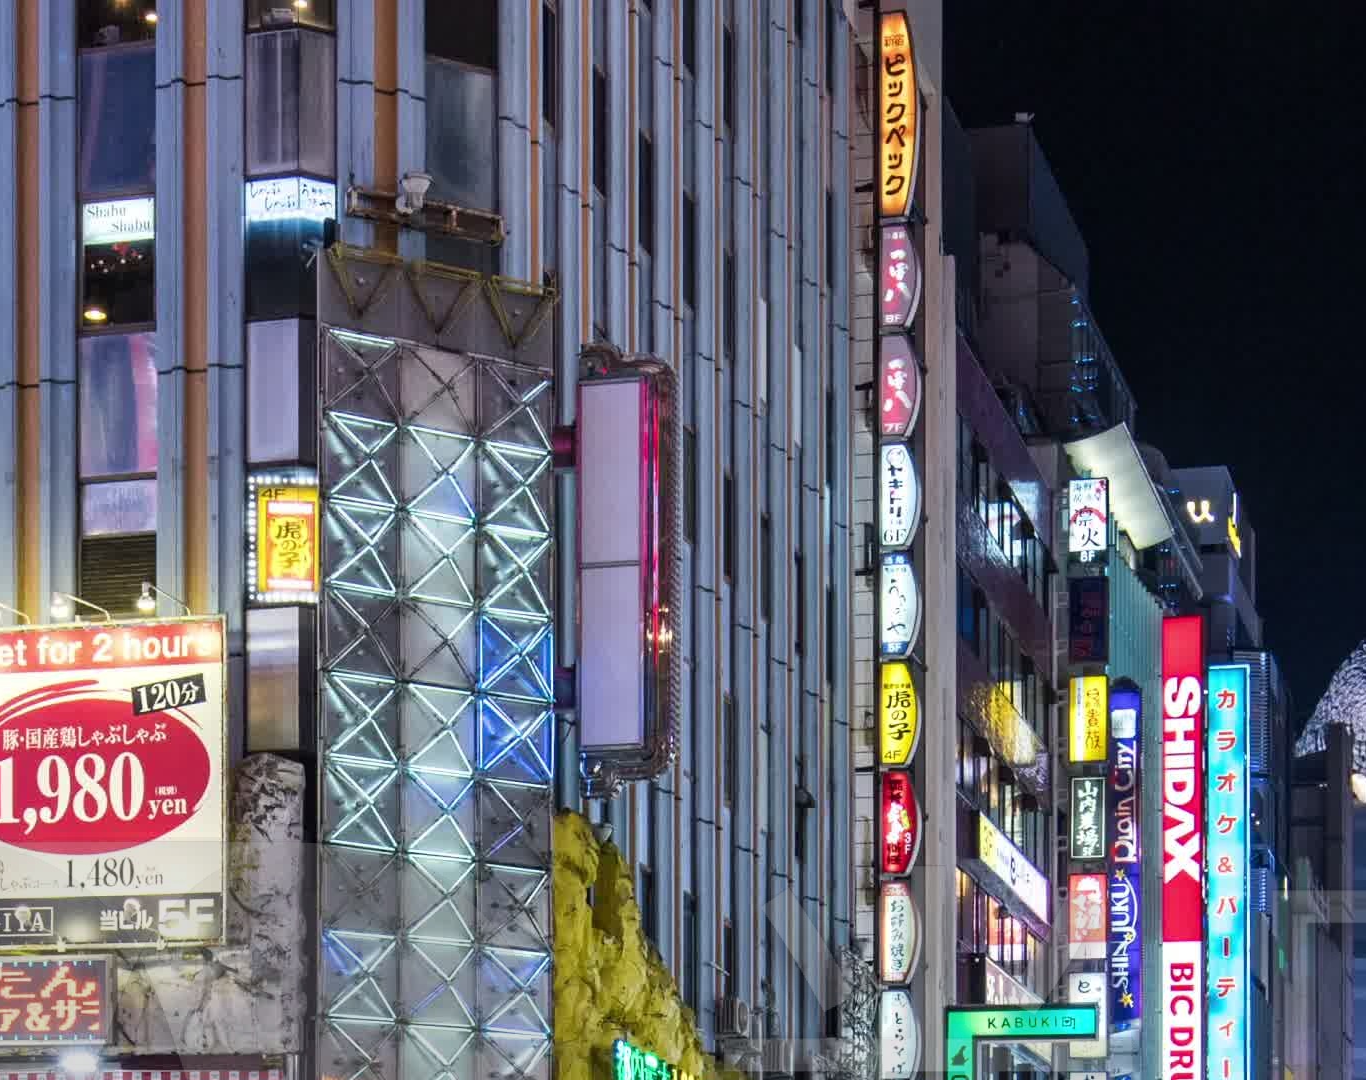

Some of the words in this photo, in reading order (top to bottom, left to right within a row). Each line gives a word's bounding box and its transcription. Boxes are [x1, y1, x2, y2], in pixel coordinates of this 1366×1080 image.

[884, 54, 906, 197] ビックペック
[884, 422, 905, 433] 7F
[275, 519, 307, 571] 虎の子
[883, 528, 907, 543] 6F
[36, 636, 80, 665] for
[92, 635, 113, 664] 2
[120, 630, 213, 662] hours
[135, 680, 203, 713] 120分
[885, 690, 915, 741] 虎の子
[883, 749, 902, 762] 4F
[1163, 676, 1202, 882] SHIDAX
[145, 796, 188, 819] yen
[65, 857, 133, 889] 1,480
[134, 869, 164, 888] yen
[158, 898, 215, 936] 5F
[889, 897, 906, 972] お好み焼き
[1113, 881, 1133, 991] SHINJUKU
[1168, 961, 1195, 1016] BIC
